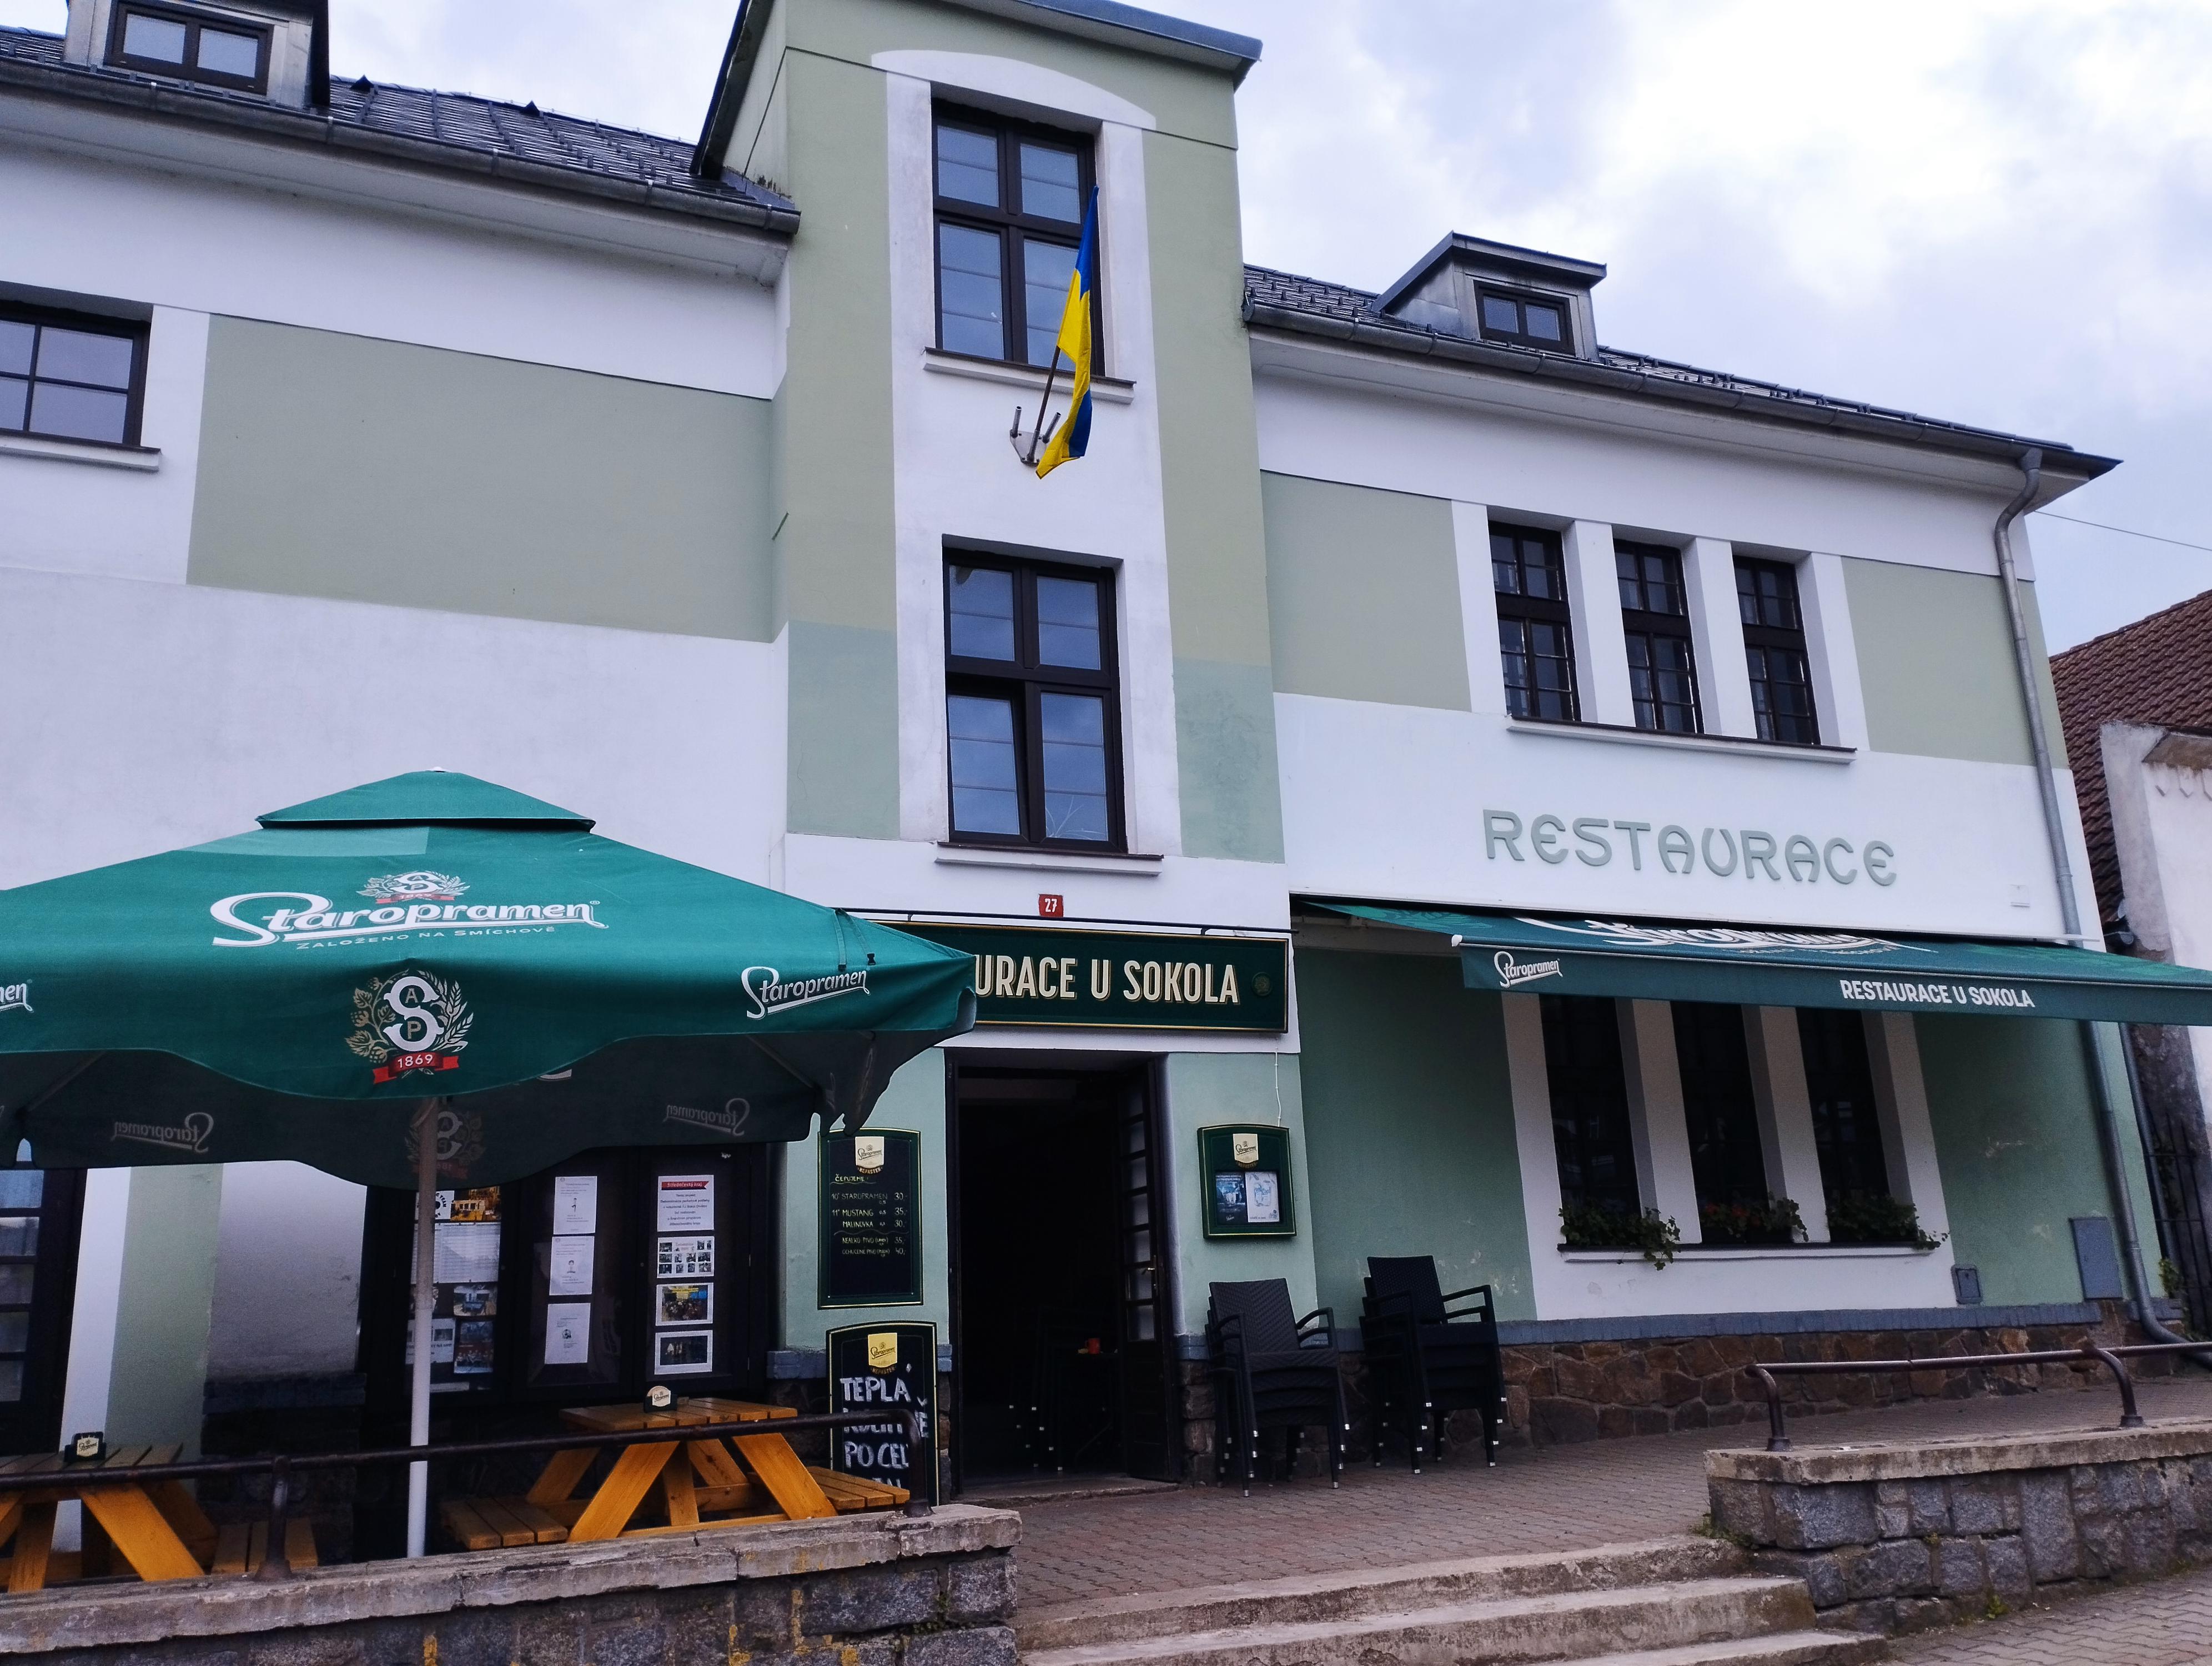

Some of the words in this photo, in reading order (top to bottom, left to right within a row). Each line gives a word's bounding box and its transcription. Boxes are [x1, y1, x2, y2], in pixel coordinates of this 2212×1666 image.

[1483, 809, 1897, 886] RESTAURACE
[210, 892, 609, 946] Staropramen
[1045, 898, 1057, 912] 27
[296, 935, 409, 950] ZALOŽENO
[454, 926, 555, 936] SMÍCHOVĚ
[1091, 959, 1111, 1000] U
[1123, 960, 1240, 1004] SOKOLA
[1494, 951, 1563, 988] Staropramen
[741, 966, 871, 1020] Staropramen
[1839, 980, 1952, 1003] RESTAURACE
[1952, 986, 1967, 1004] U
[1970, 986, 2035, 1008] SOKOLA
[398, 1053, 433, 1068] 1869
[844, 1441, 874, 1468] PO
[877, 1443, 909, 1469] CEL
